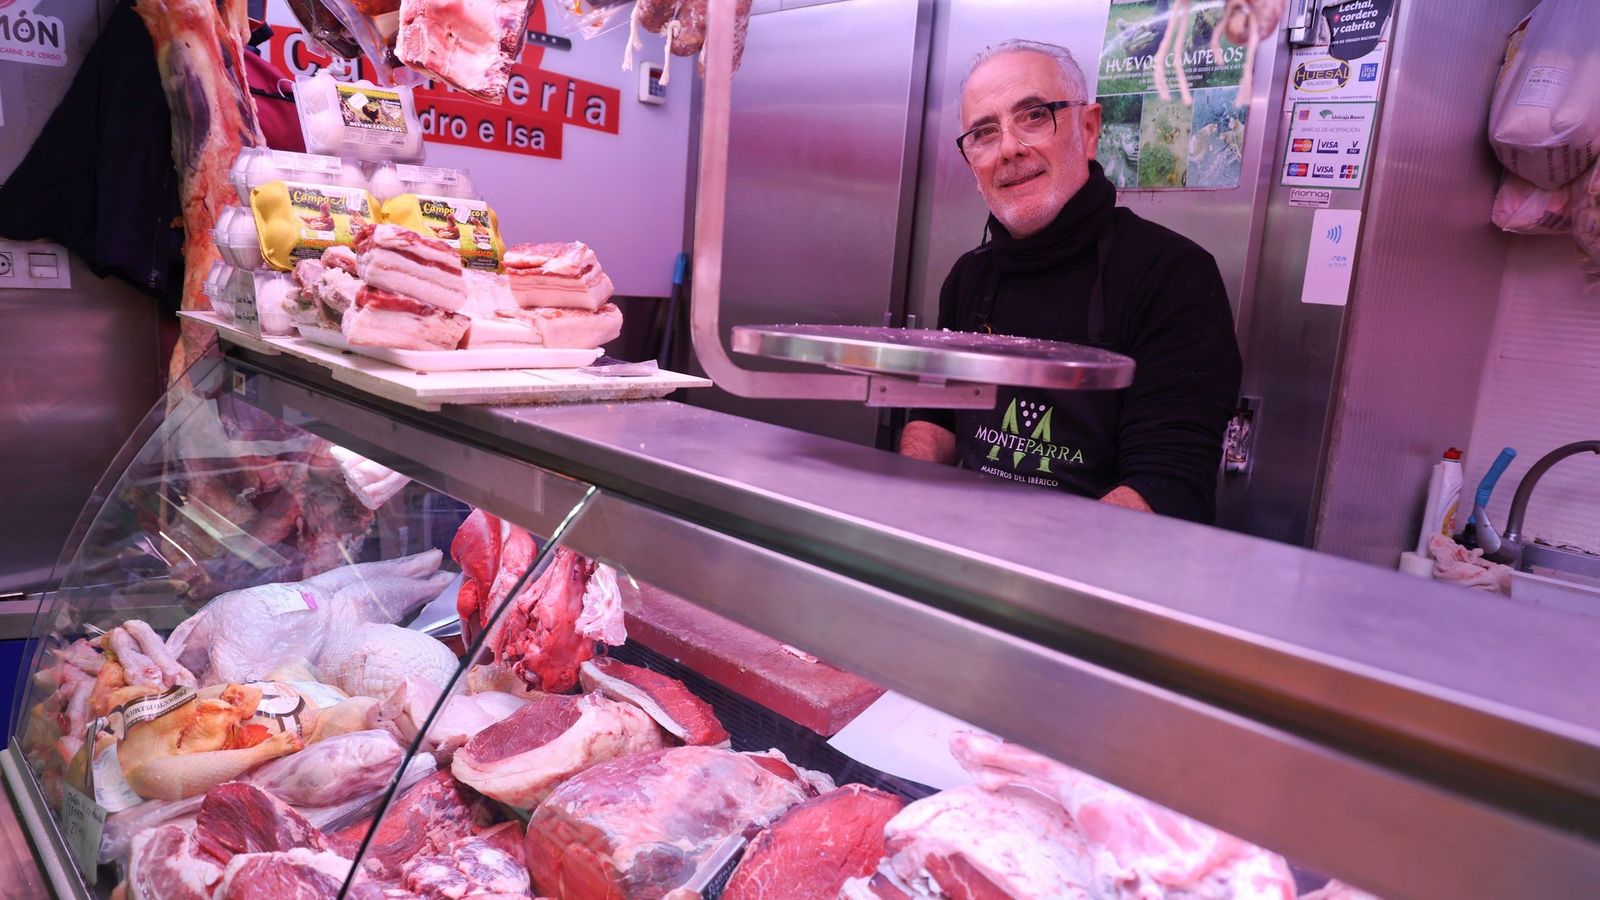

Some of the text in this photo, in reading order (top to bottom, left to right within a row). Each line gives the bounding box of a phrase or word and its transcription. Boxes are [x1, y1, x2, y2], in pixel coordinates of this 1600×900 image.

[1339, 0, 1374, 12] Lechal,
[1340, 9, 1379, 22] cordero
[1333, 20, 1376, 37] y cabrito
[1296, 66, 1349, 81] HUESAL
[478, 121, 495, 143] e
[506, 120, 545, 151] Isa
[1316, 165, 1334, 173] VISA
[293, 190, 330, 206] Campo
[423, 202, 454, 216] Campo
[974, 425, 1084, 464] MONTEPARRA
[980, 465, 1059, 487] MAESTROS DEL IBÉRICO
